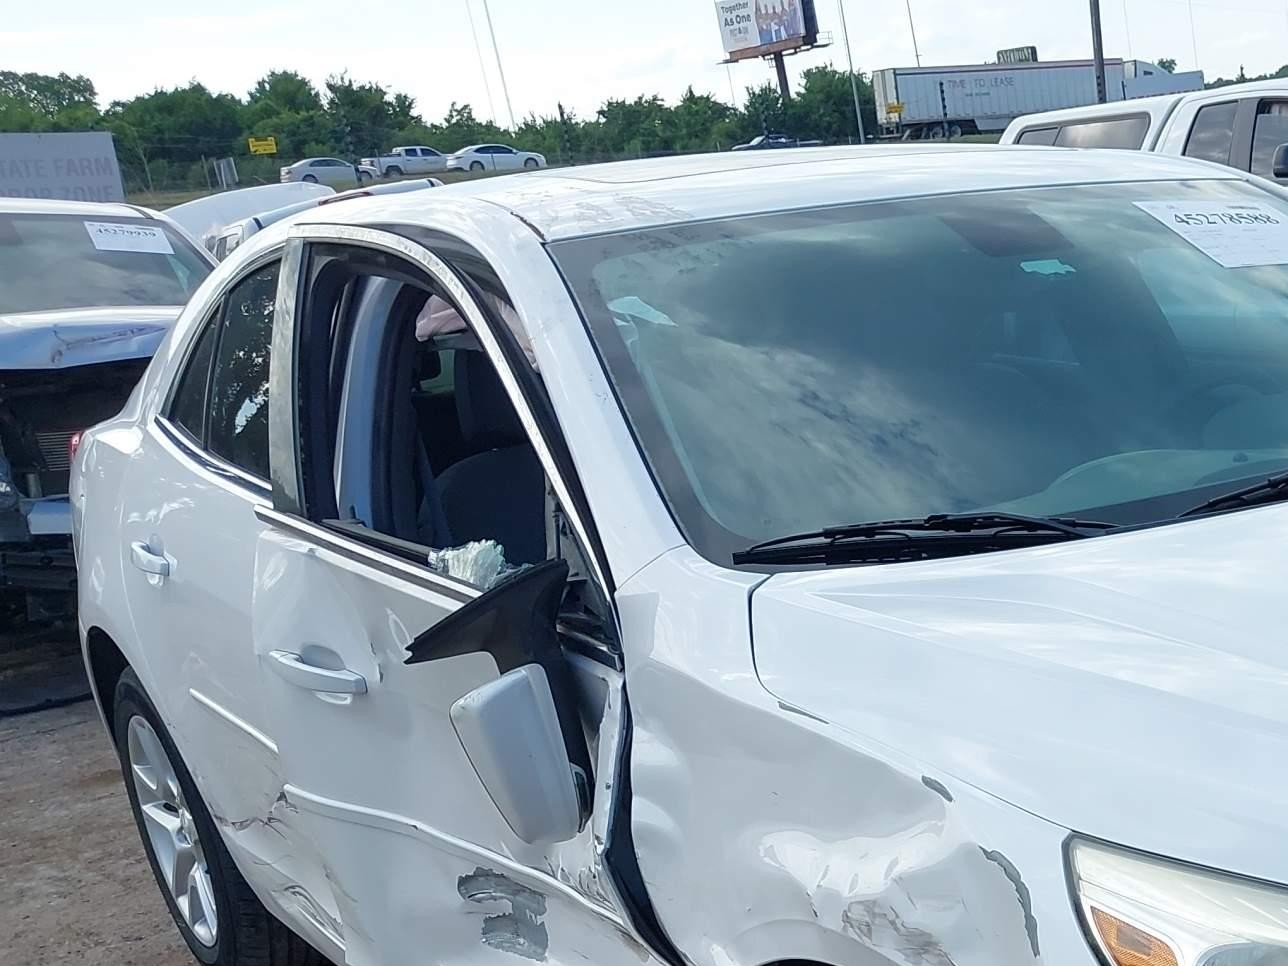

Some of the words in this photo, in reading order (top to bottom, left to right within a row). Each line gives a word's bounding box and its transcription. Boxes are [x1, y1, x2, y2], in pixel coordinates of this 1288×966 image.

[720, 1, 749, 14] Together
[724, 17, 735, 27] As
[735, 14, 752, 25] One
[947, 79, 967, 89] TIME
[974, 79, 986, 89] TO
[991, 77, 1015, 87] LEASE
[53, 157, 114, 177] FARM
[1174, 213, 1280, 226] 45278588
